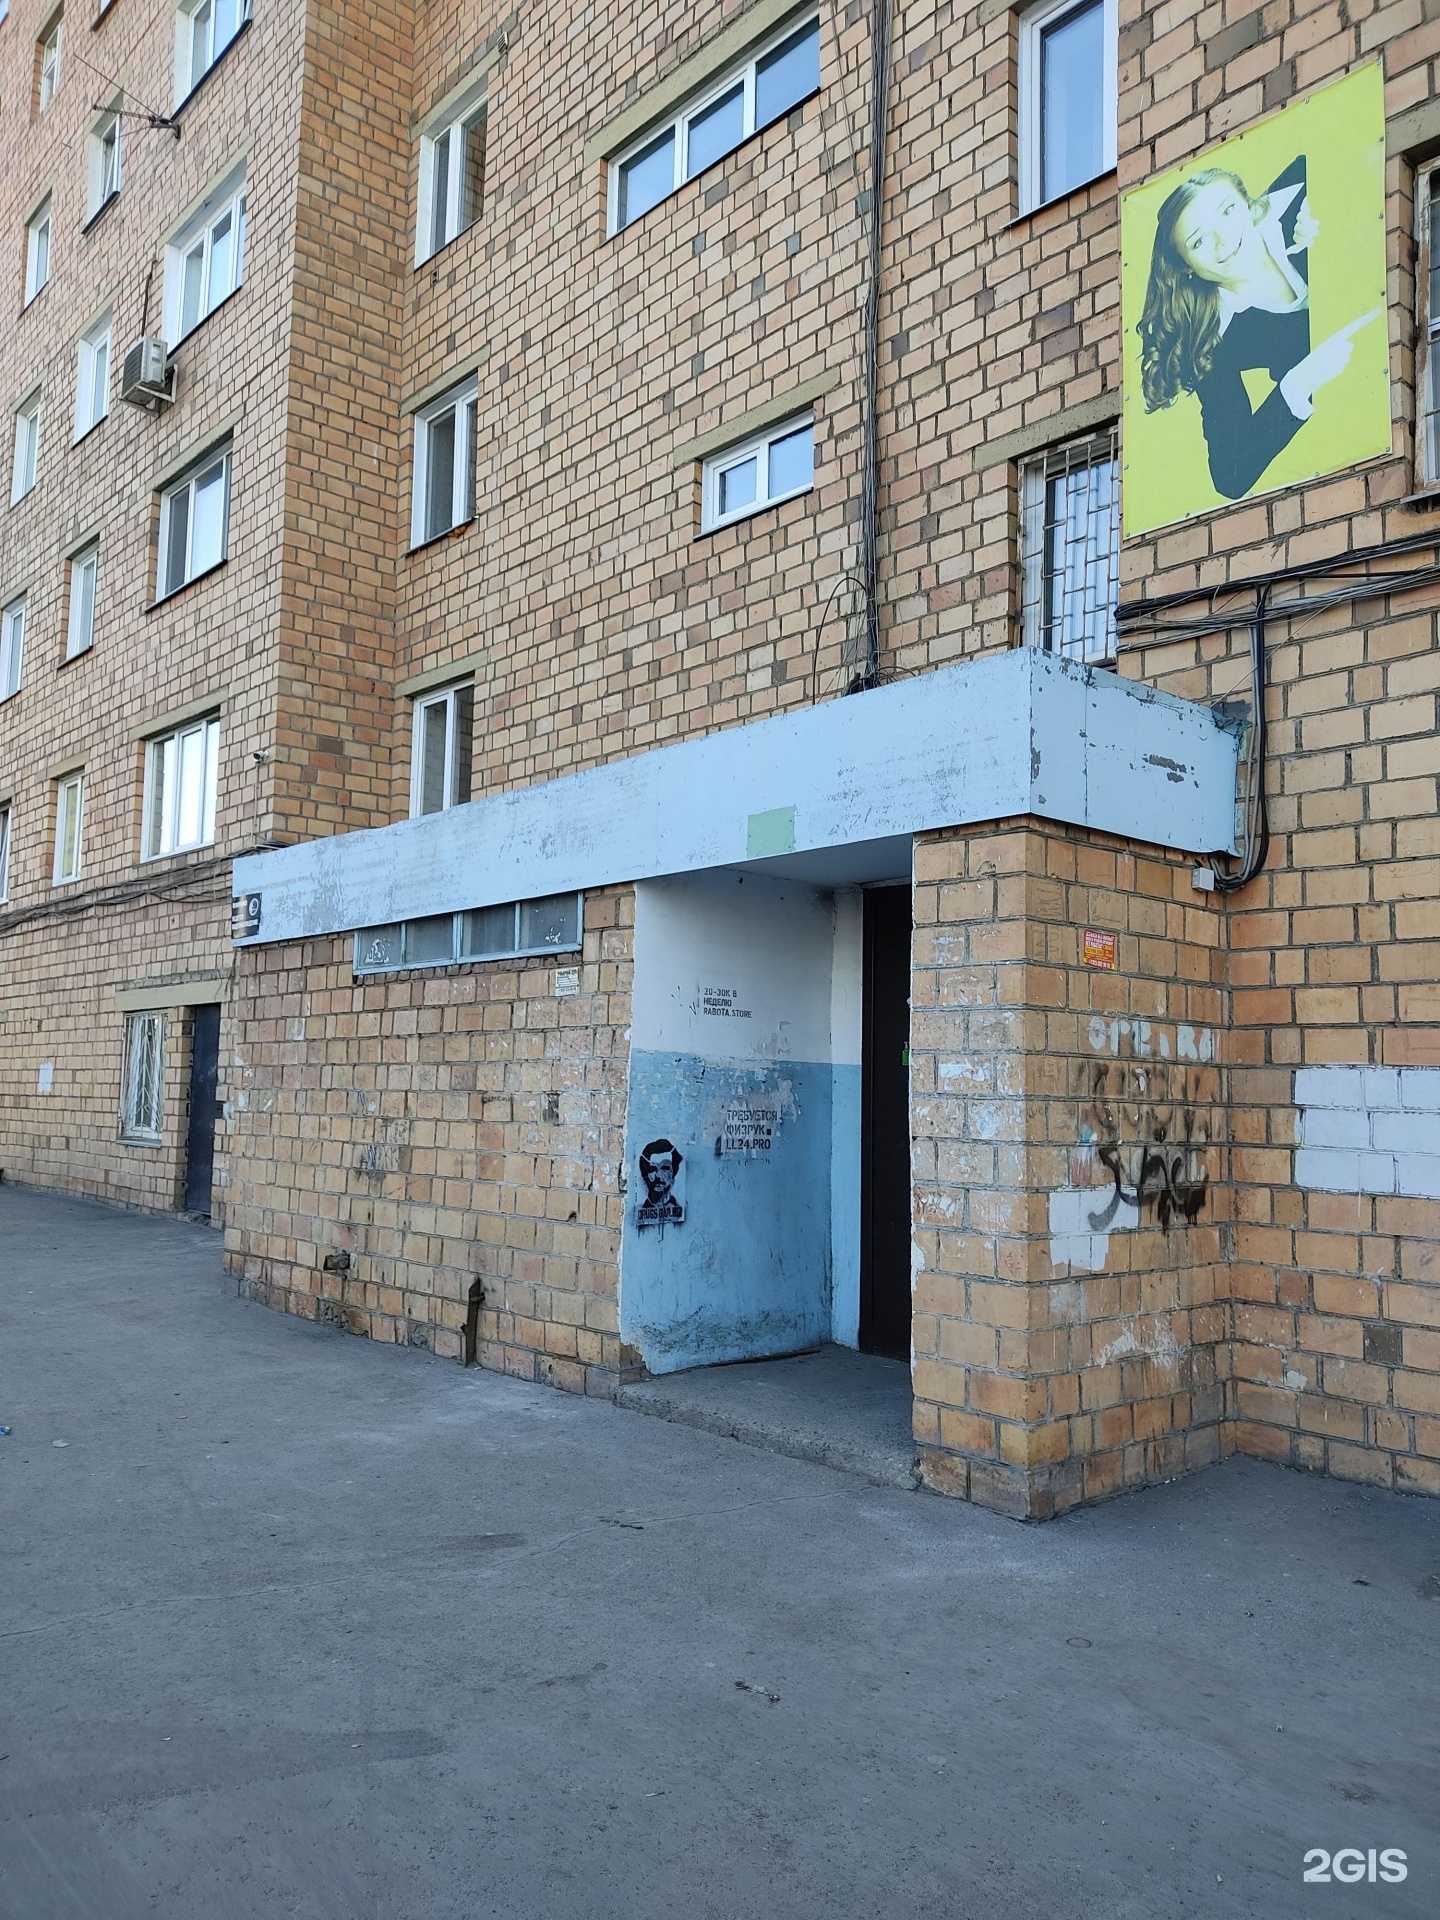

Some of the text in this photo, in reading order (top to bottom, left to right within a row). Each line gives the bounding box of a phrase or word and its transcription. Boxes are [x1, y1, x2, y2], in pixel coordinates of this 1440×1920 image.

[703, 997, 732, 1007] НЕДЕЛЮ
[703, 1007, 753, 1019] RABOTA.STORE
[727, 1109, 778, 1121] ТРЕБУЕТСЯ
[726, 1138, 771, 1150] LL24.PRO
